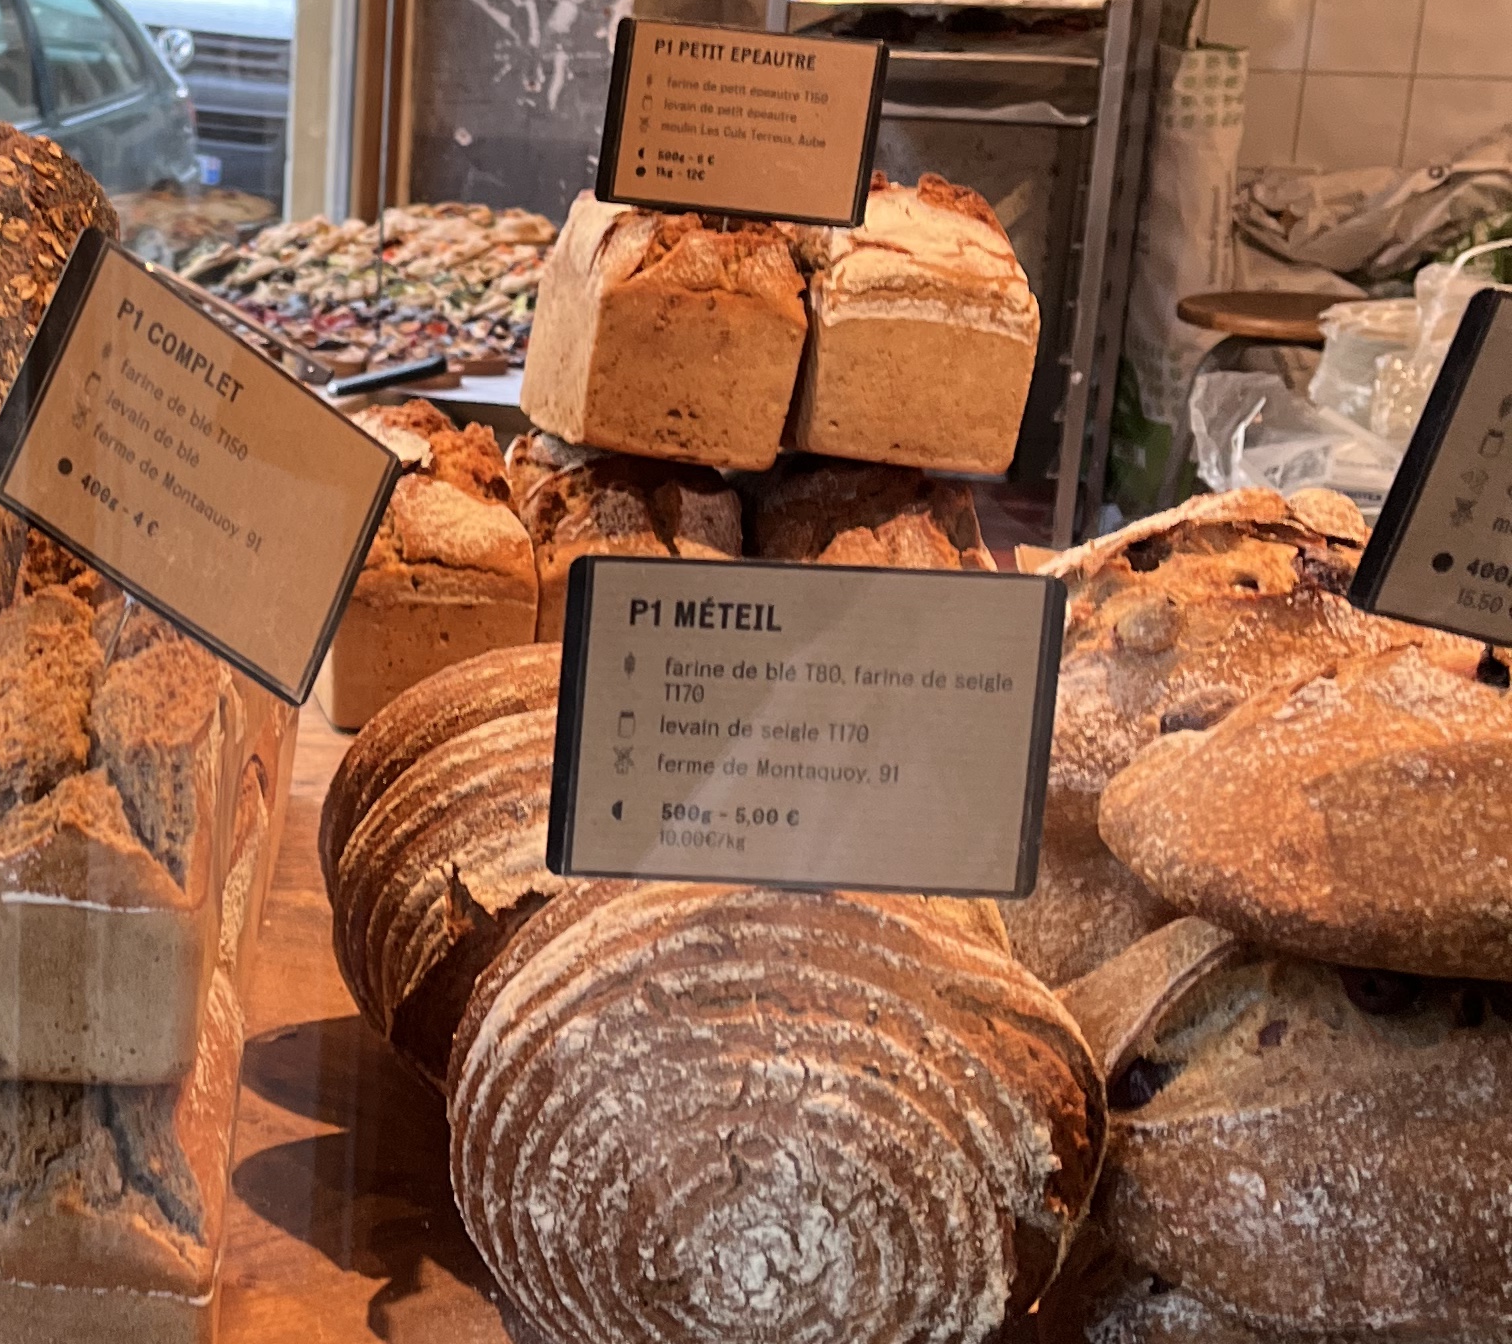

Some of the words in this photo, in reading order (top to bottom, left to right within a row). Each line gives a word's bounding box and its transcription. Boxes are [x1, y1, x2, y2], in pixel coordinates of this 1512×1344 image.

[653, 38, 672, 55] P1
[678, 40, 724, 61] PETIT
[730, 46, 816, 70] EPEAUTRE
[666, 75, 699, 91] farine
[702, 79, 717, 92] de
[719, 82, 746, 96] petit
[663, 97, 696, 112] levain
[699, 102, 714, 114] de
[716, 104, 743, 117] petit
[660, 120, 697, 134] moulin
[699, 123, 720, 137] Les
[655, 165, 673, 179] 1kg
[685, 168, 705, 182] 12€
[657, 149, 685, 163] 500g
[706, 154, 715, 166] €
[115, 296, 144, 331] P1
[146, 319, 244, 404] COMPLET
[119, 357, 165, 402] farine
[165, 392, 188, 418] de
[188, 407, 214, 437] blé
[104, 389, 151, 433] levain
[152, 424, 174, 450] de
[175, 439, 201, 468] blé
[91, 421, 137, 465] ferme
[137, 455, 160, 481] de
[244, 528, 264, 554] 91
[78, 472, 120, 512] 400g
[131, 508, 145, 529] 4
[145, 518, 160, 539] €
[628, 595, 662, 627] P1
[674, 596, 782, 631] MÉTEIL
[664, 656, 724, 679] farine
[731, 659, 758, 681] de
[764, 660, 796, 683] blé
[853, 664, 914, 687] farine
[920, 667, 947, 690] de
[954, 670, 1013, 693] seigle
[663, 682, 705, 703] T170
[659, 715, 719, 738] levain
[726, 718, 753, 739] de
[761, 721, 819, 743] seigle
[827, 722, 869, 744] T170
[656, 753, 715, 776] ferme
[722, 757, 748, 778] de
[878, 763, 899, 785] 91
[660, 802, 711, 824] 500g
[734, 805, 779, 826] 5,00
[785, 808, 799, 828] €
